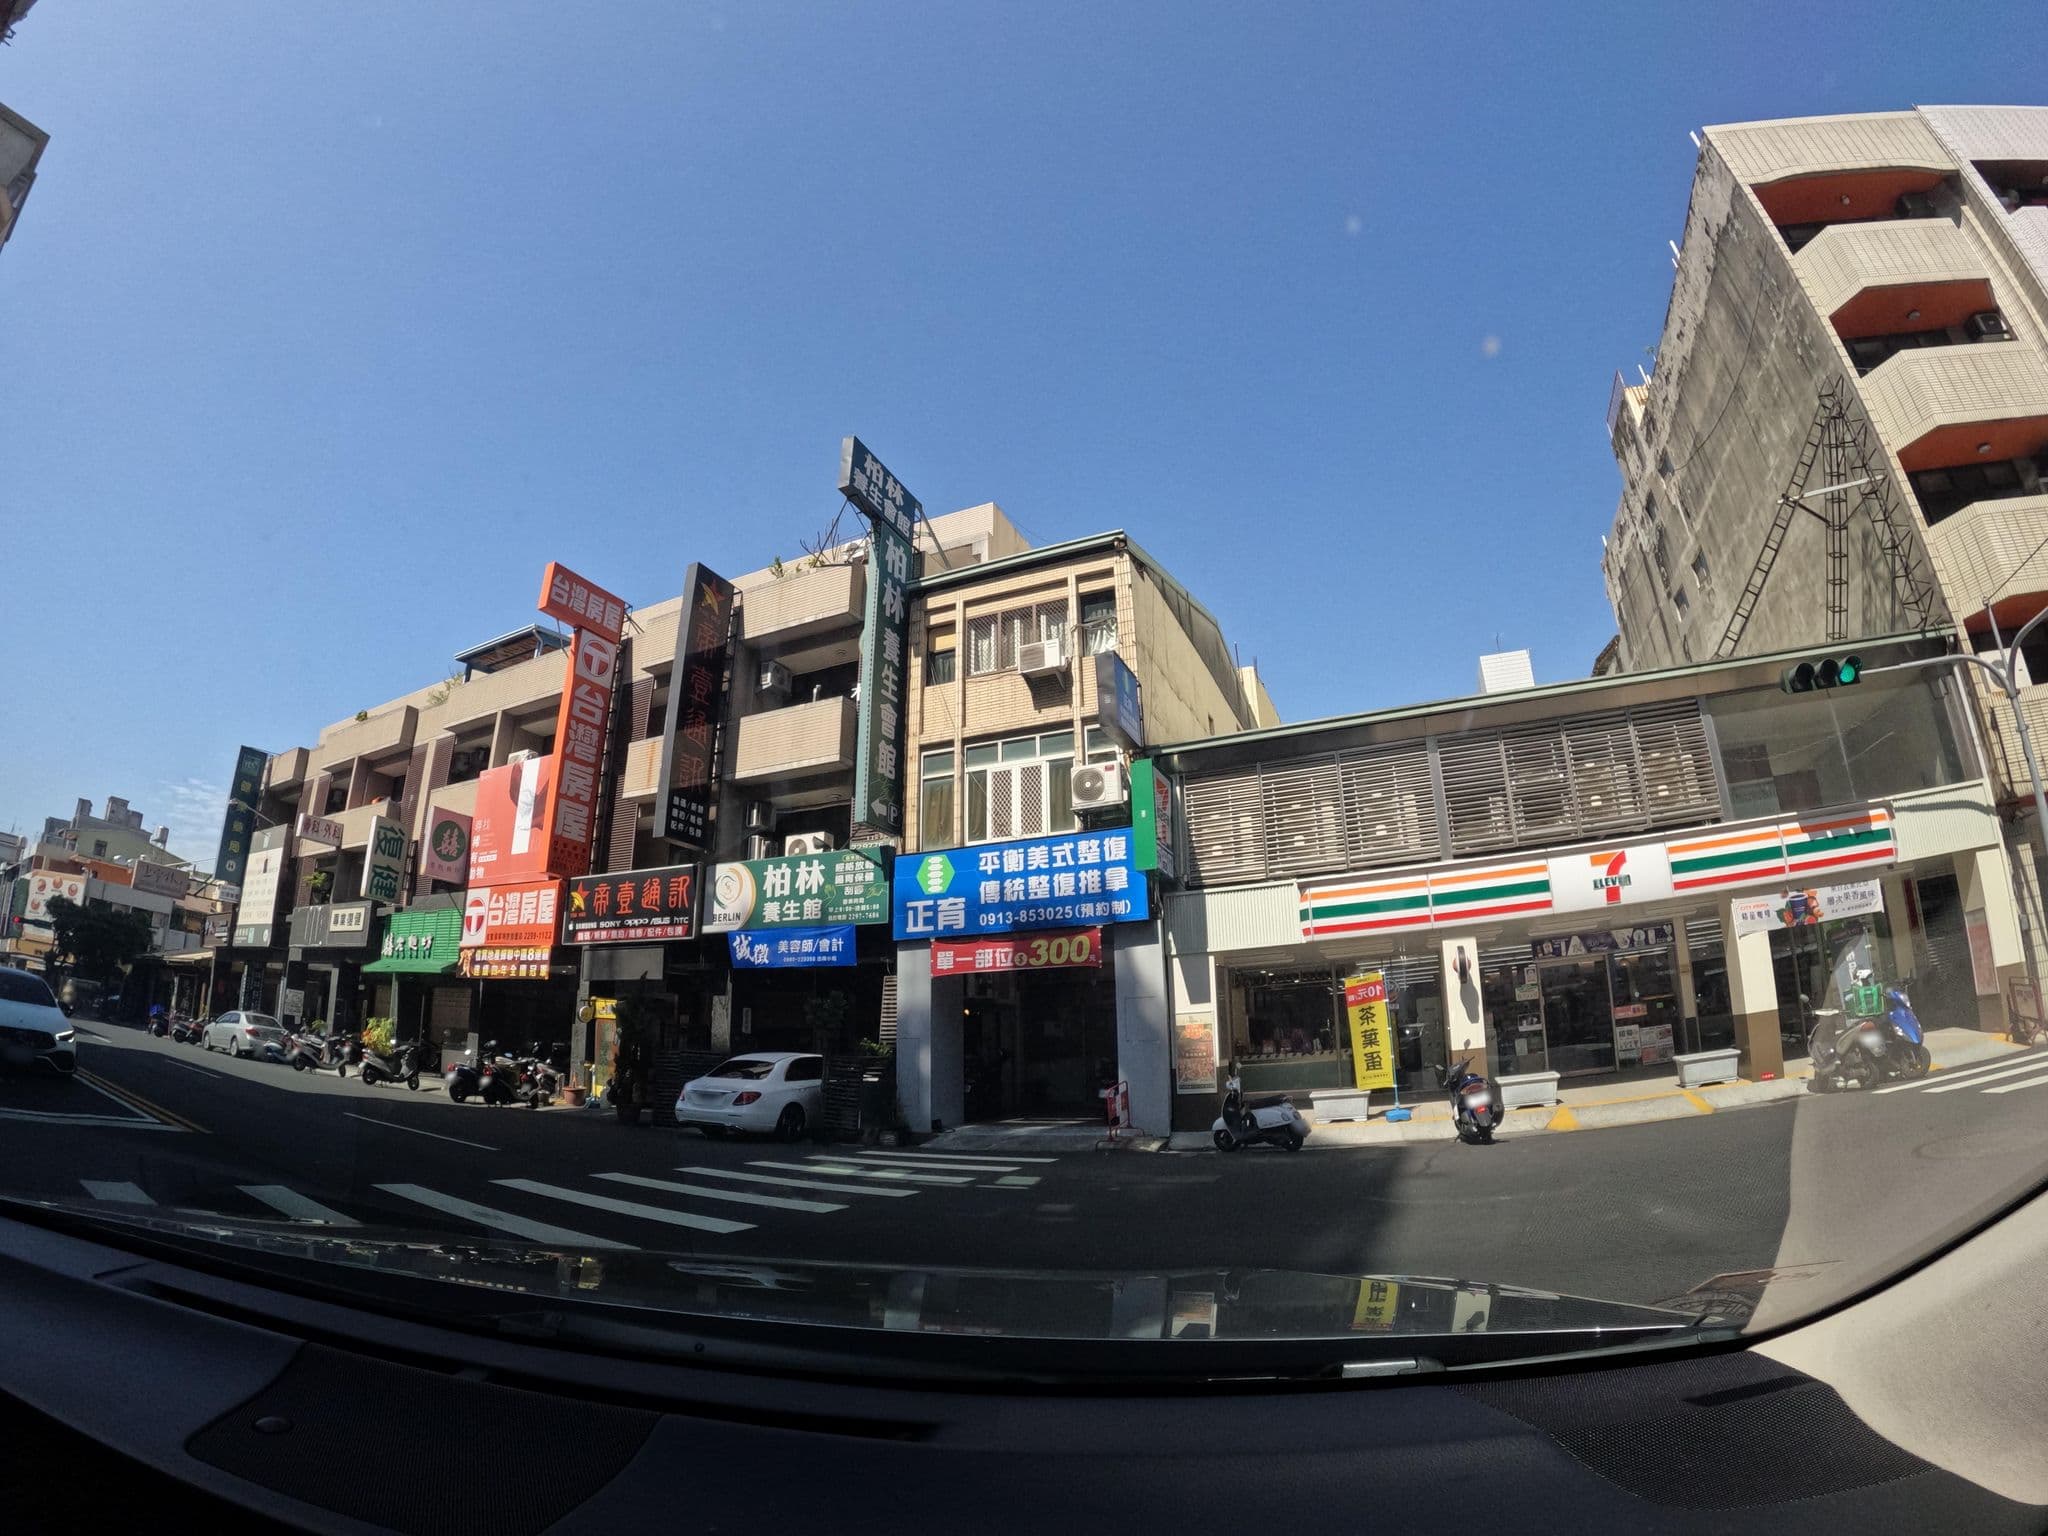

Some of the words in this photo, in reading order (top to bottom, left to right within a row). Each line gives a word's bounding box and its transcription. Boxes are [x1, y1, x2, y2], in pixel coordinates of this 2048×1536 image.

[865, 452, 904, 506] 柏林
[854, 467, 912, 538] 養生會館
[552, 574, 621, 632] 台灣房屋
[555, 683, 606, 842] 台灣房屋
[369, 825, 405, 898] 復健
[978, 836, 1127, 876] 平衡美式整復
[593, 875, 690, 917] 帝壹通訊
[763, 859, 826, 898] 柏林
[979, 866, 1129, 905] 傳統整復推拿
[488, 888, 556, 926] 台灣房屋
[600, 920, 621, 929] SONY
[650, 916, 670, 925] ASUS
[712, 911, 741, 922] BERLIN
[762, 898, 823, 923] 養生館
[906, 897, 966, 933] 正育
[733, 935, 769, 965] 誠徵
[778, 938, 844, 953] 美容師/會計
[936, 947, 1014, 970] 單一部位
[1029, 935, 1090, 966] 300
